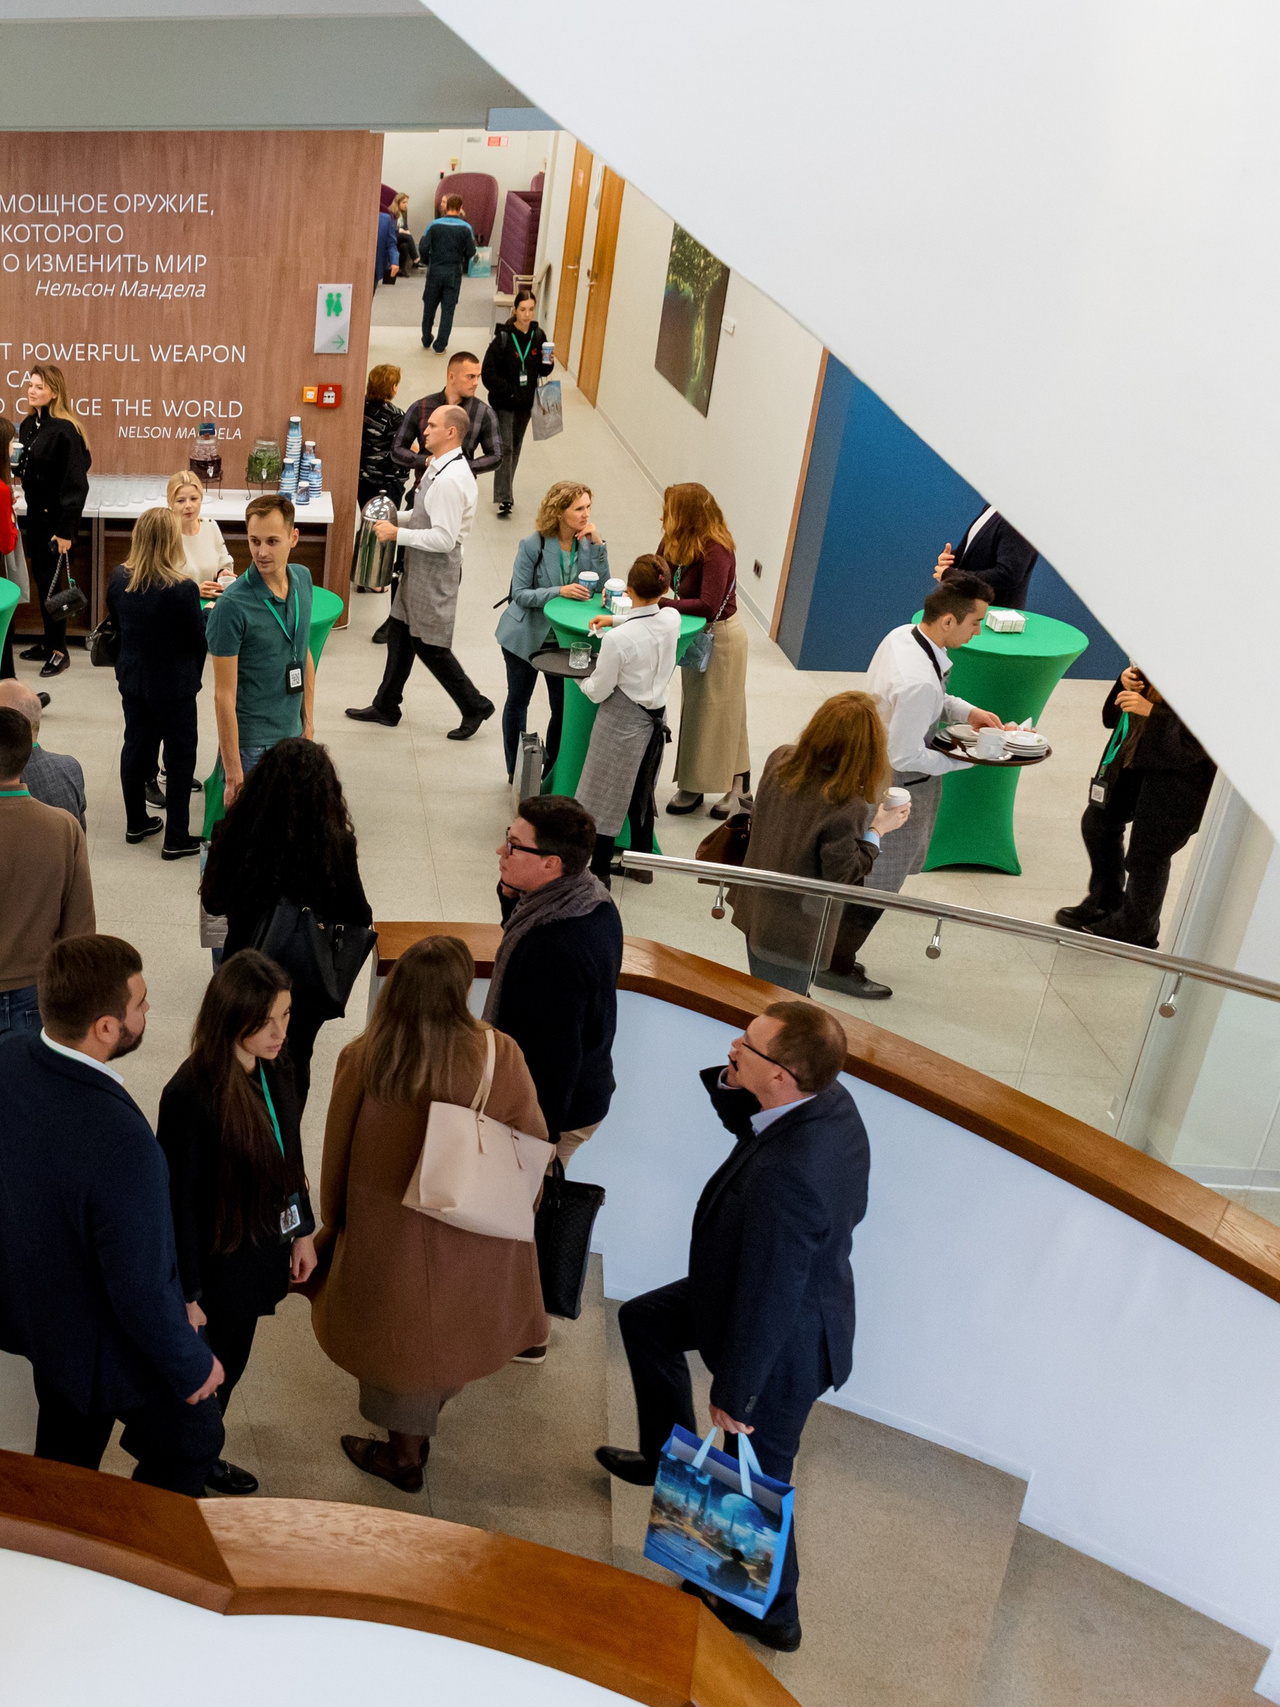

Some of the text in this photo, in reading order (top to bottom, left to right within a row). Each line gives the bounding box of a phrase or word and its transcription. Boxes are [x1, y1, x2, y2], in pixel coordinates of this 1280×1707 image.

[113, 193, 214, 216] ОРУЖИЕ,
[1, 223, 124, 244] КОТОРОГО
[26, 253, 149, 273] ИЗМЕНИТЬ
[155, 254, 207, 274] МИР
[35, 279, 207, 300] Нельсон Мандела
[22, 342, 141, 362] POWERFUL
[149, 344, 246, 363] WEAPON
[6, 370, 31, 388] CA
[111, 398, 152, 417] THE
[162, 399, 243, 418] WORLD
[117, 426, 242, 440] NELSON MAELA
